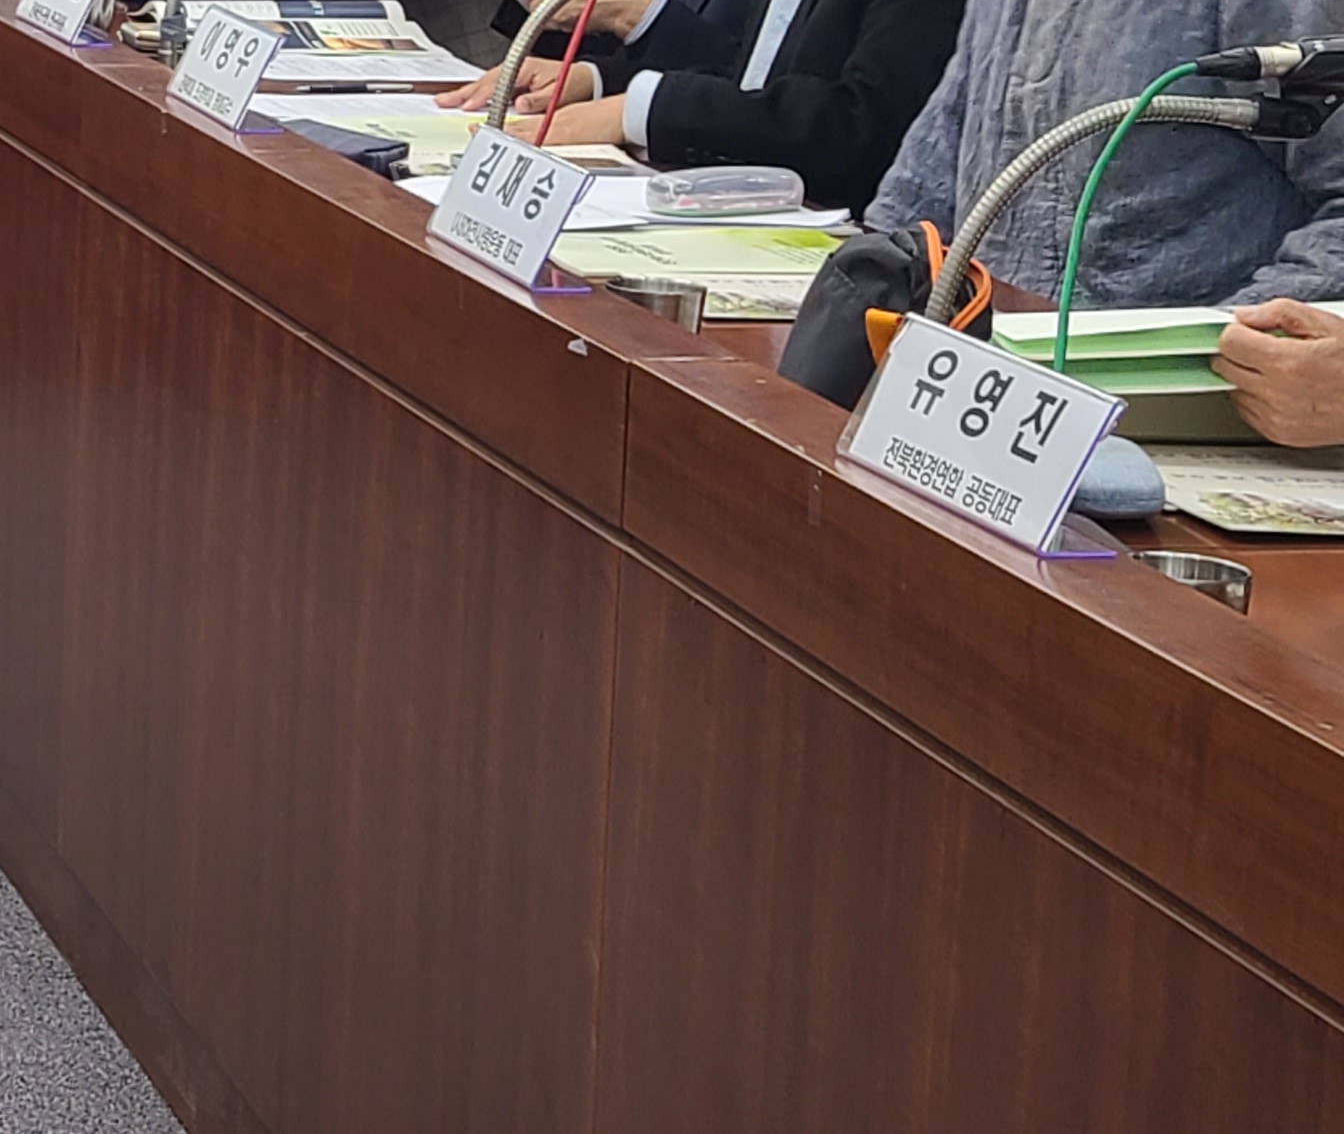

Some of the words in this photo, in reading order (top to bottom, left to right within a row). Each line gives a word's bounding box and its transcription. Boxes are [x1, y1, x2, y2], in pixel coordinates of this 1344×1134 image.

[471, 142, 555, 220] 김재승
[910, 350, 1068, 464] 유영진
[883, 436, 964, 498] 전북환경연합
[962, 475, 1023, 525] 공동대표
